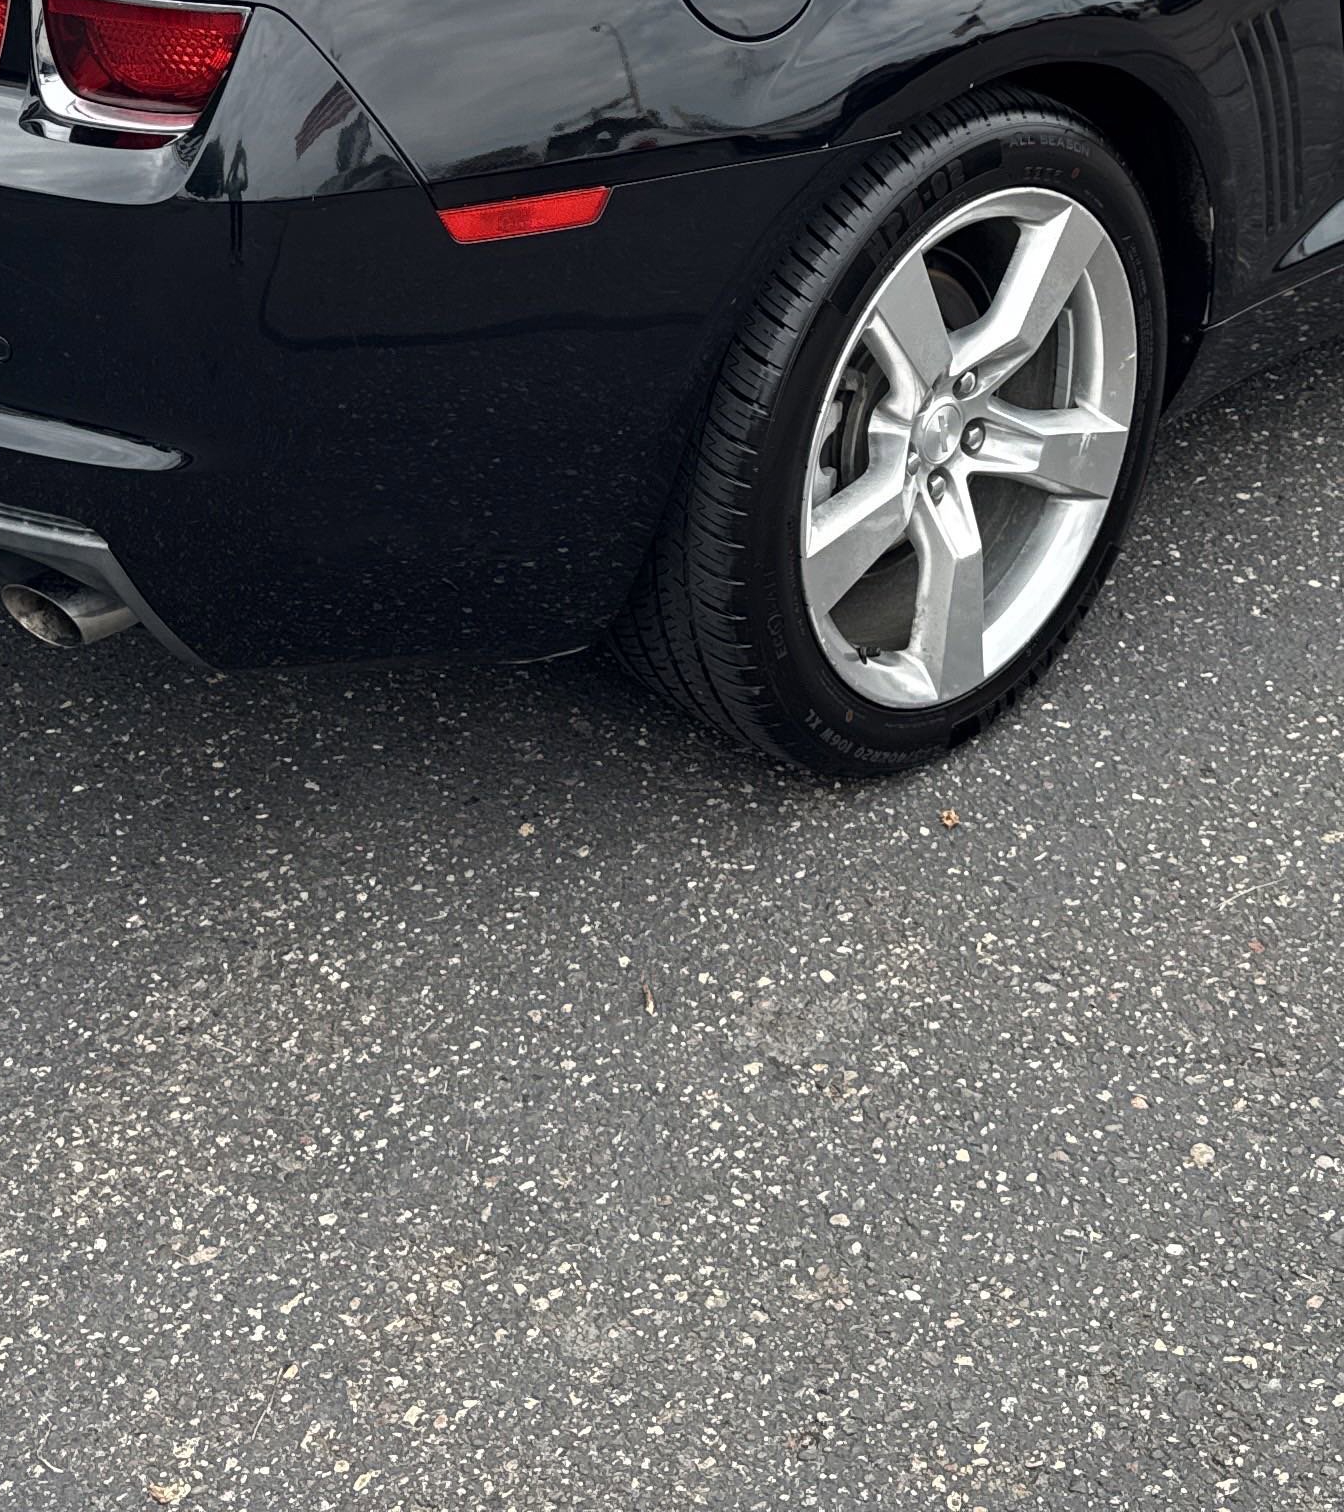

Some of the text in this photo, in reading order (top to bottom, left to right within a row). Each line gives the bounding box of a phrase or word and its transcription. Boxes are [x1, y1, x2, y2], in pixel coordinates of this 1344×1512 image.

[1009, 134, 1091, 158] ALL SEASON
[802, 707, 824, 731] XL
[819, 727, 854, 754] 106W
